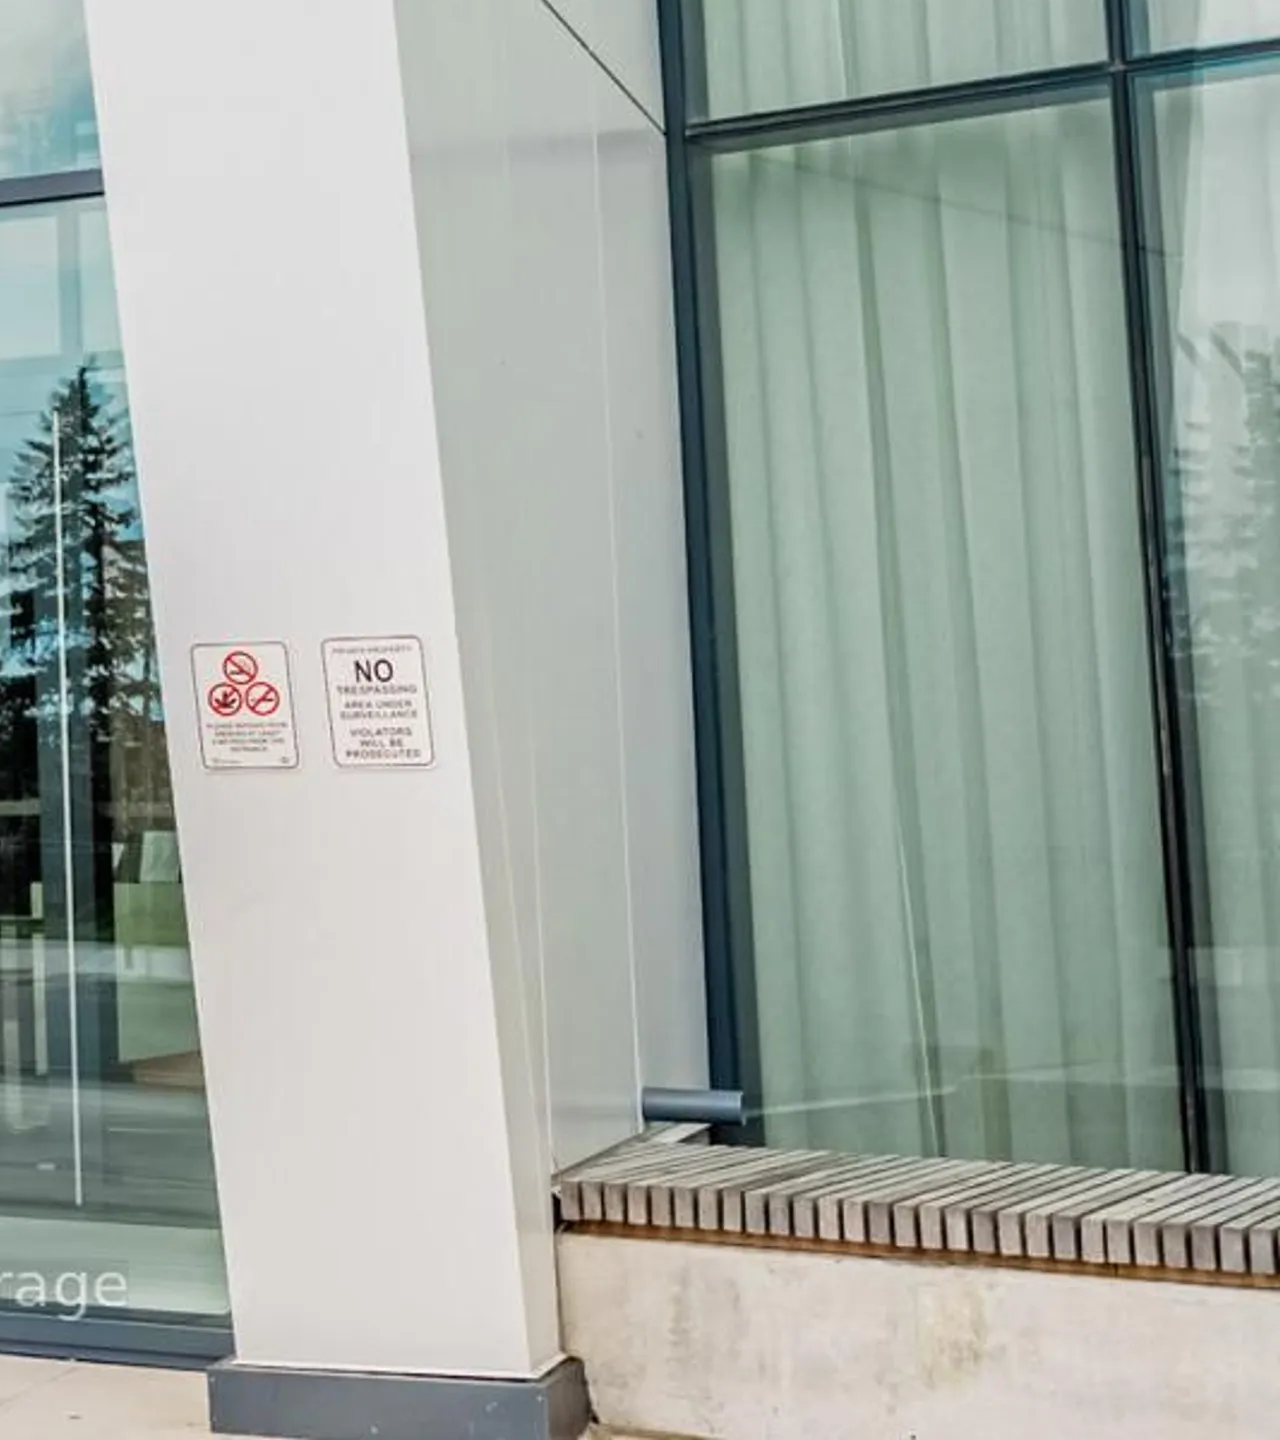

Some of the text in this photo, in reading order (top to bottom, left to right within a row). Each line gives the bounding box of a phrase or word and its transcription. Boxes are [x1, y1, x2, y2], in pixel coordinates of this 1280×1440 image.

[354, 658, 394, 682] NO
[336, 684, 418, 695] TRESPASSING
[344, 701, 372, 709] AREA
[350, 727, 413, 737] VIOLATORS
